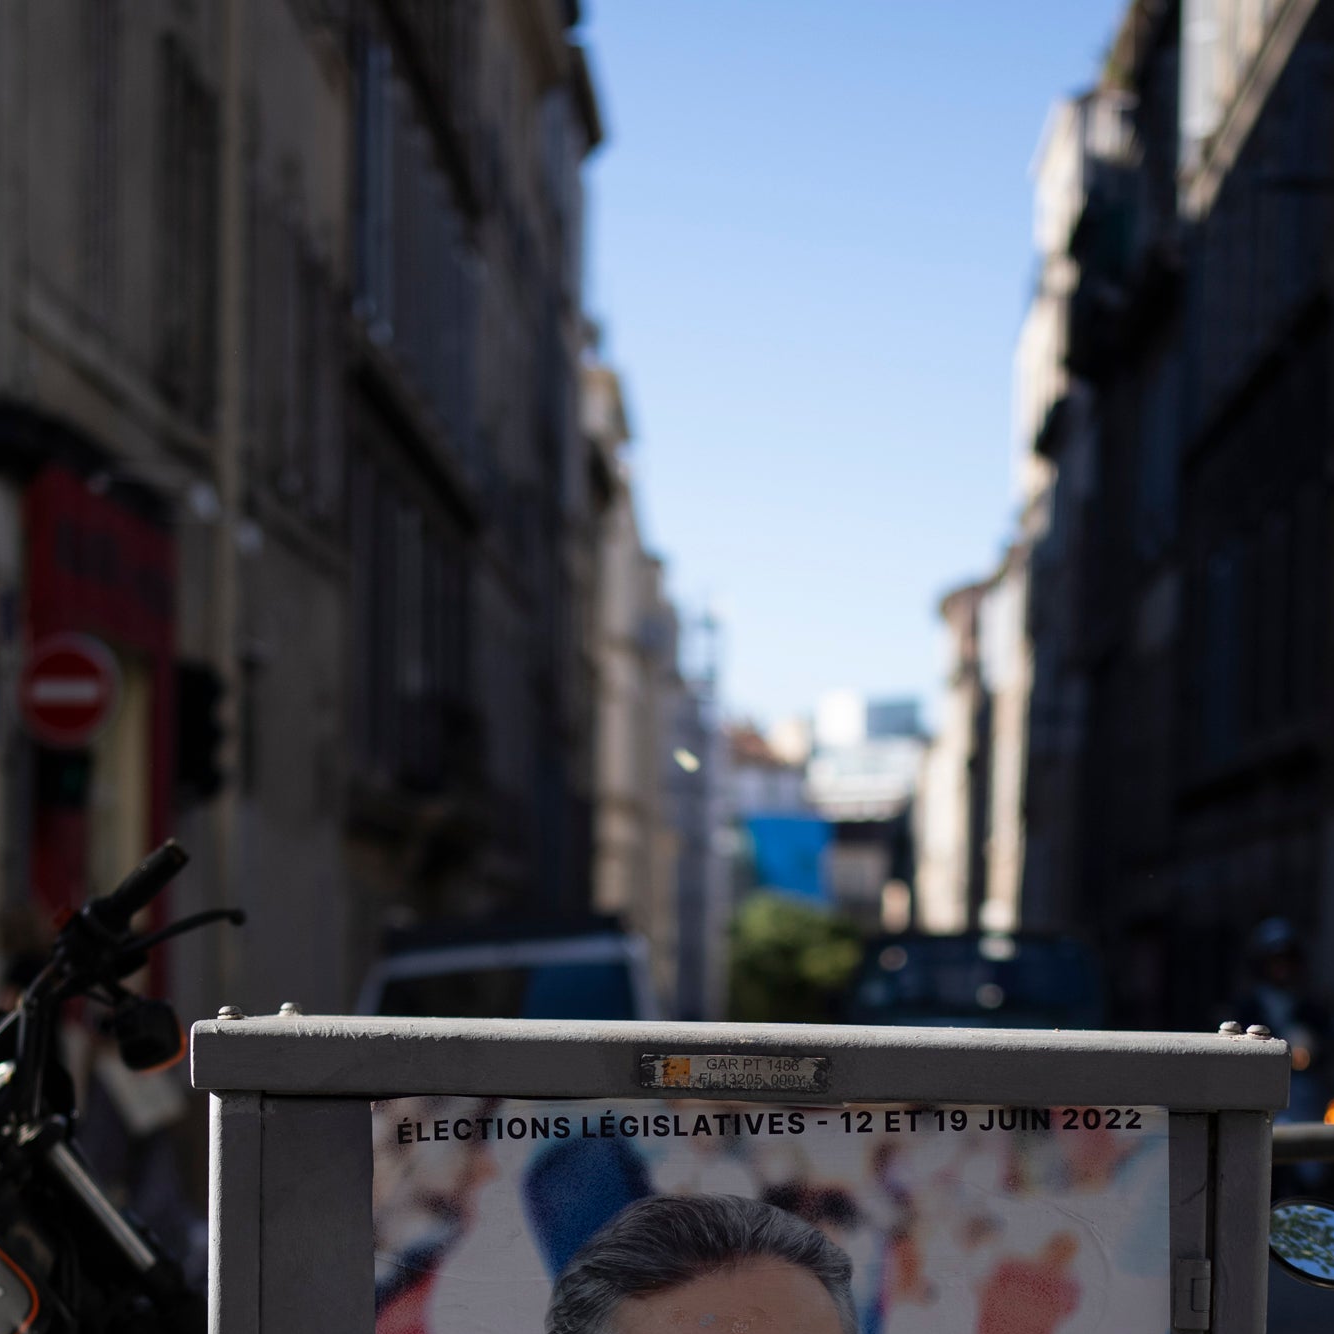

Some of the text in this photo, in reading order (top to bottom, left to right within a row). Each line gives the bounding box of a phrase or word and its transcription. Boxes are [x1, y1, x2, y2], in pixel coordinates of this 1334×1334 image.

[706, 1058, 799, 1072] GAR PT 1486
[722, 1073, 762, 1085] 13205
[397, 1117, 571, 1145] ÉLECTIONS
[581, 1109, 806, 1139] LÉGISLATIVES
[839, 1111, 873, 1134] 12
[884, 1110, 922, 1133] ET
[934, 1109, 968, 1132] 19
[979, 1108, 1051, 1131] JUIN
[1061, 1107, 1143, 1130] 2022
